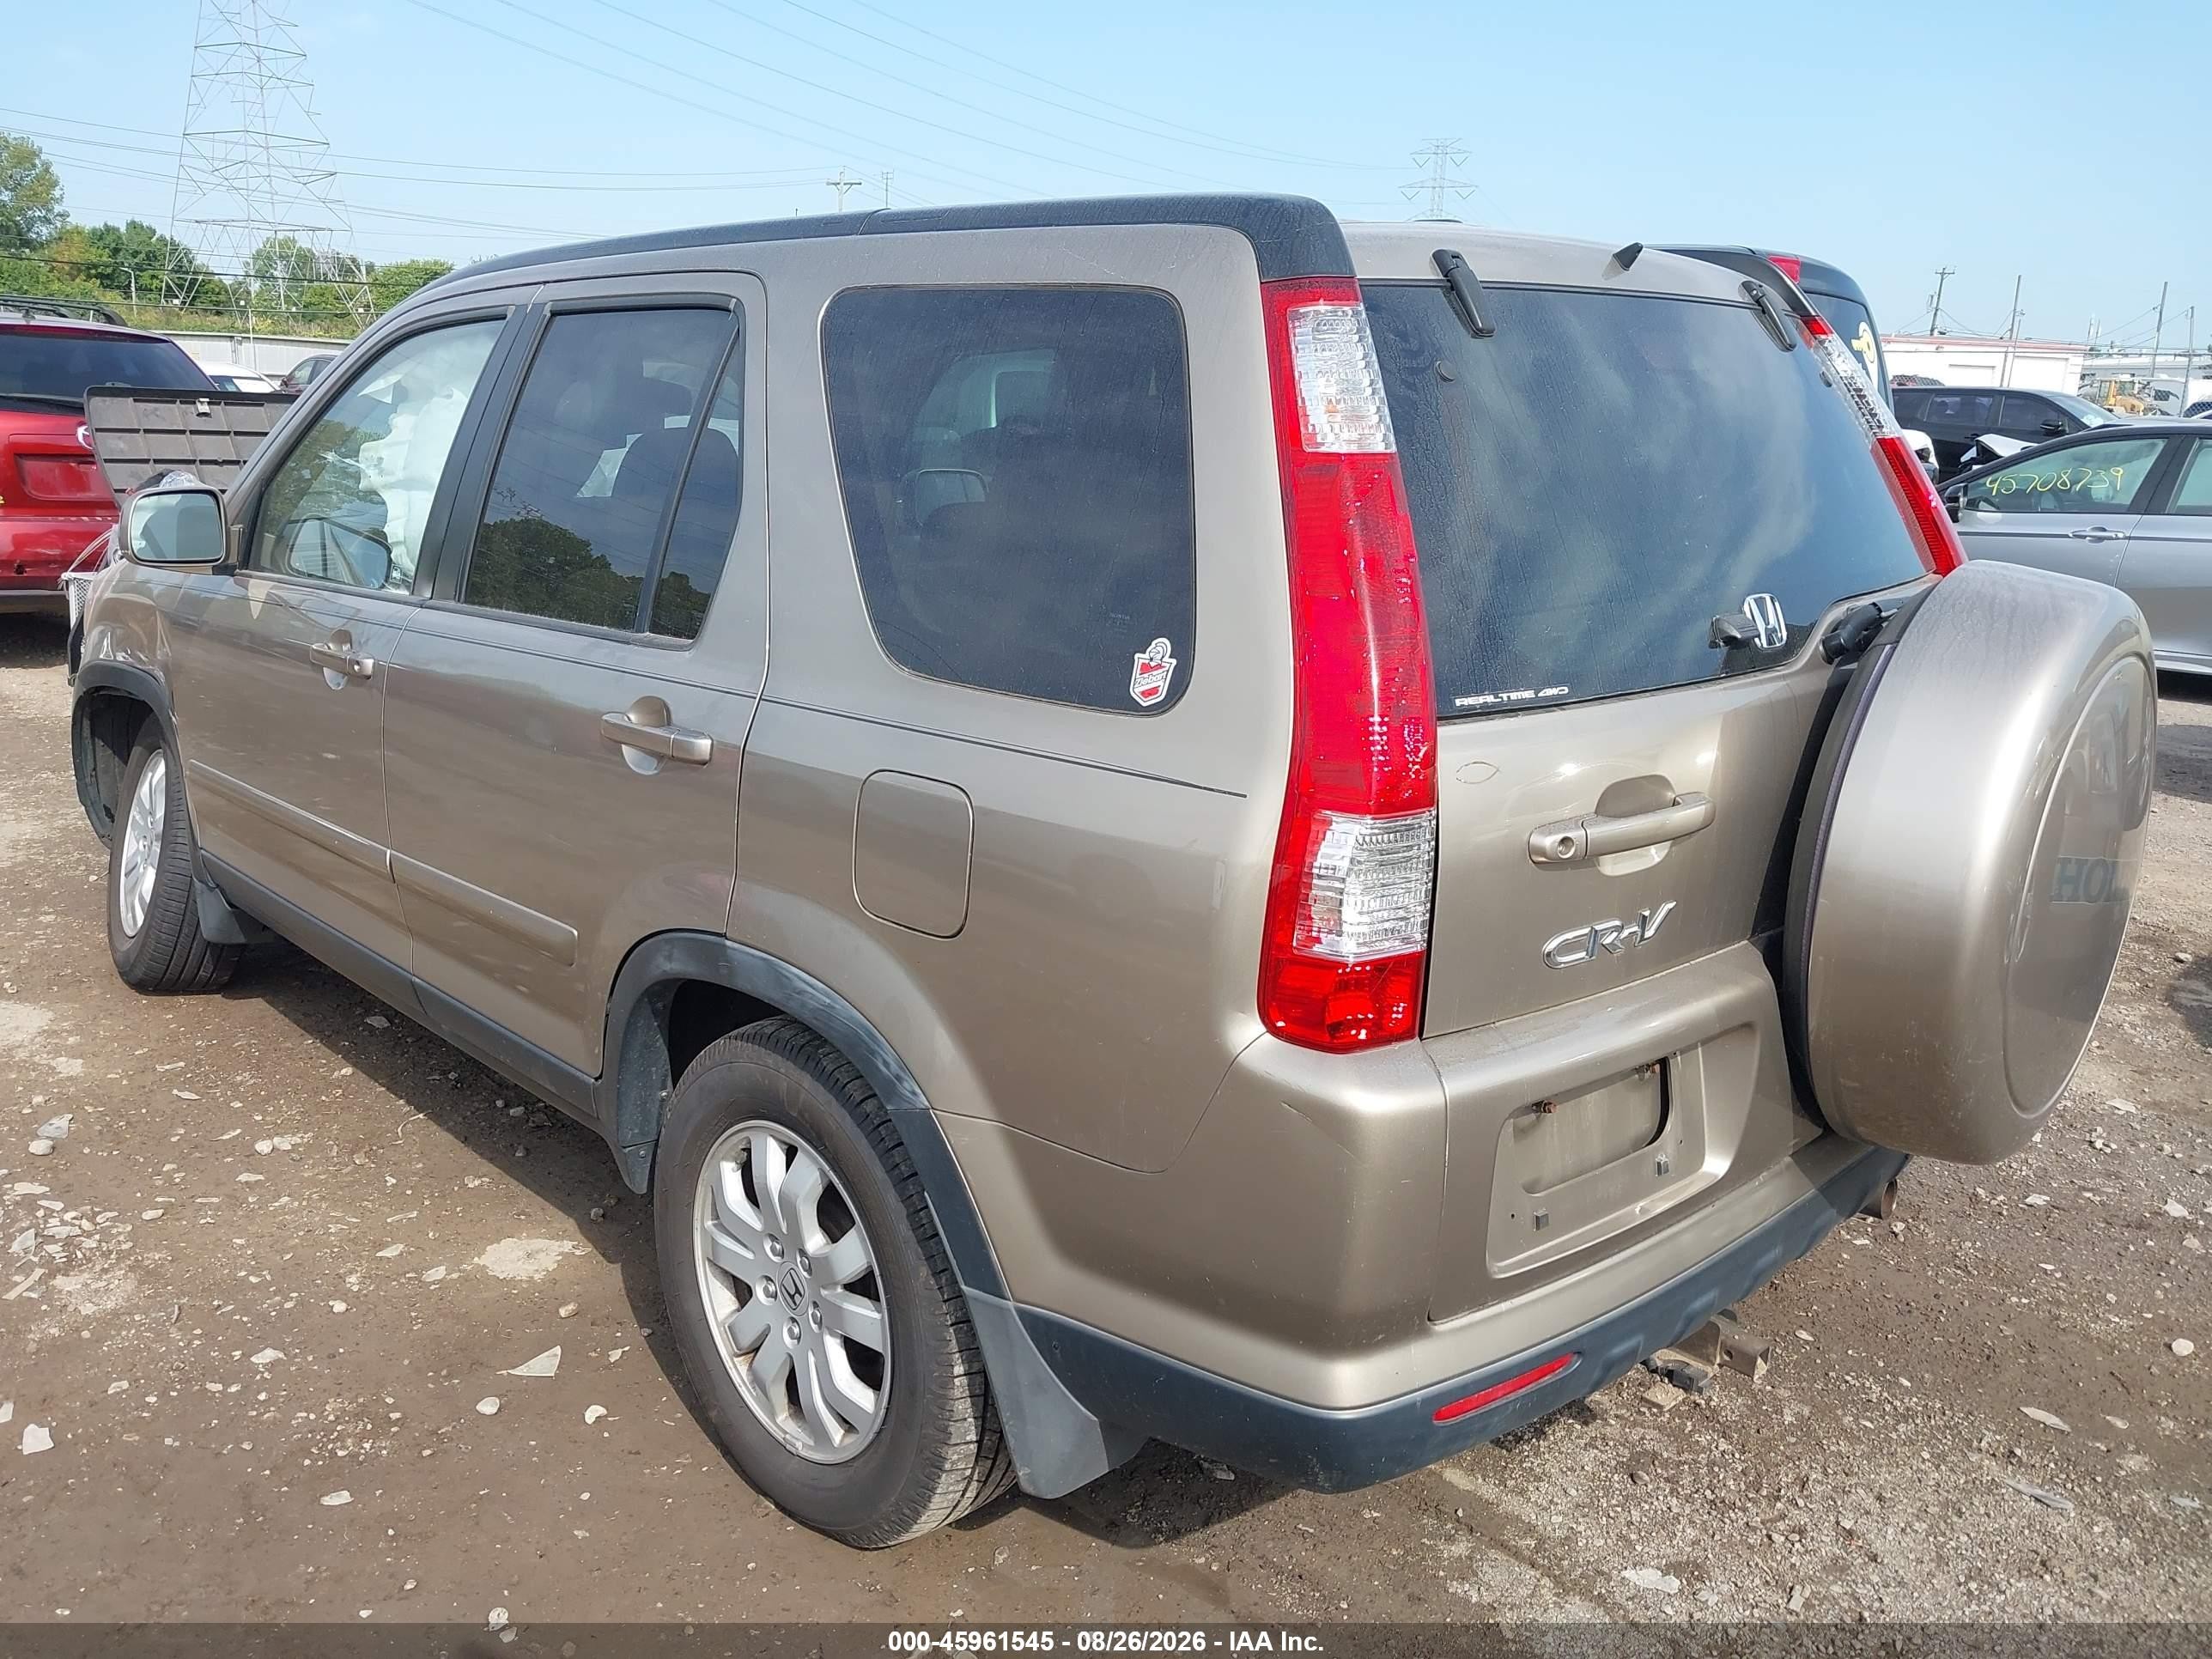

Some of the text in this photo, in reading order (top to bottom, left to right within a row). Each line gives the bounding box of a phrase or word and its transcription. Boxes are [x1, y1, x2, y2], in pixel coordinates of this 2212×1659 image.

[1985, 466, 2124, 496] 45708739
[1538, 686, 1570, 697] 4WD
[1541, 900, 1677, 969] CR-V
